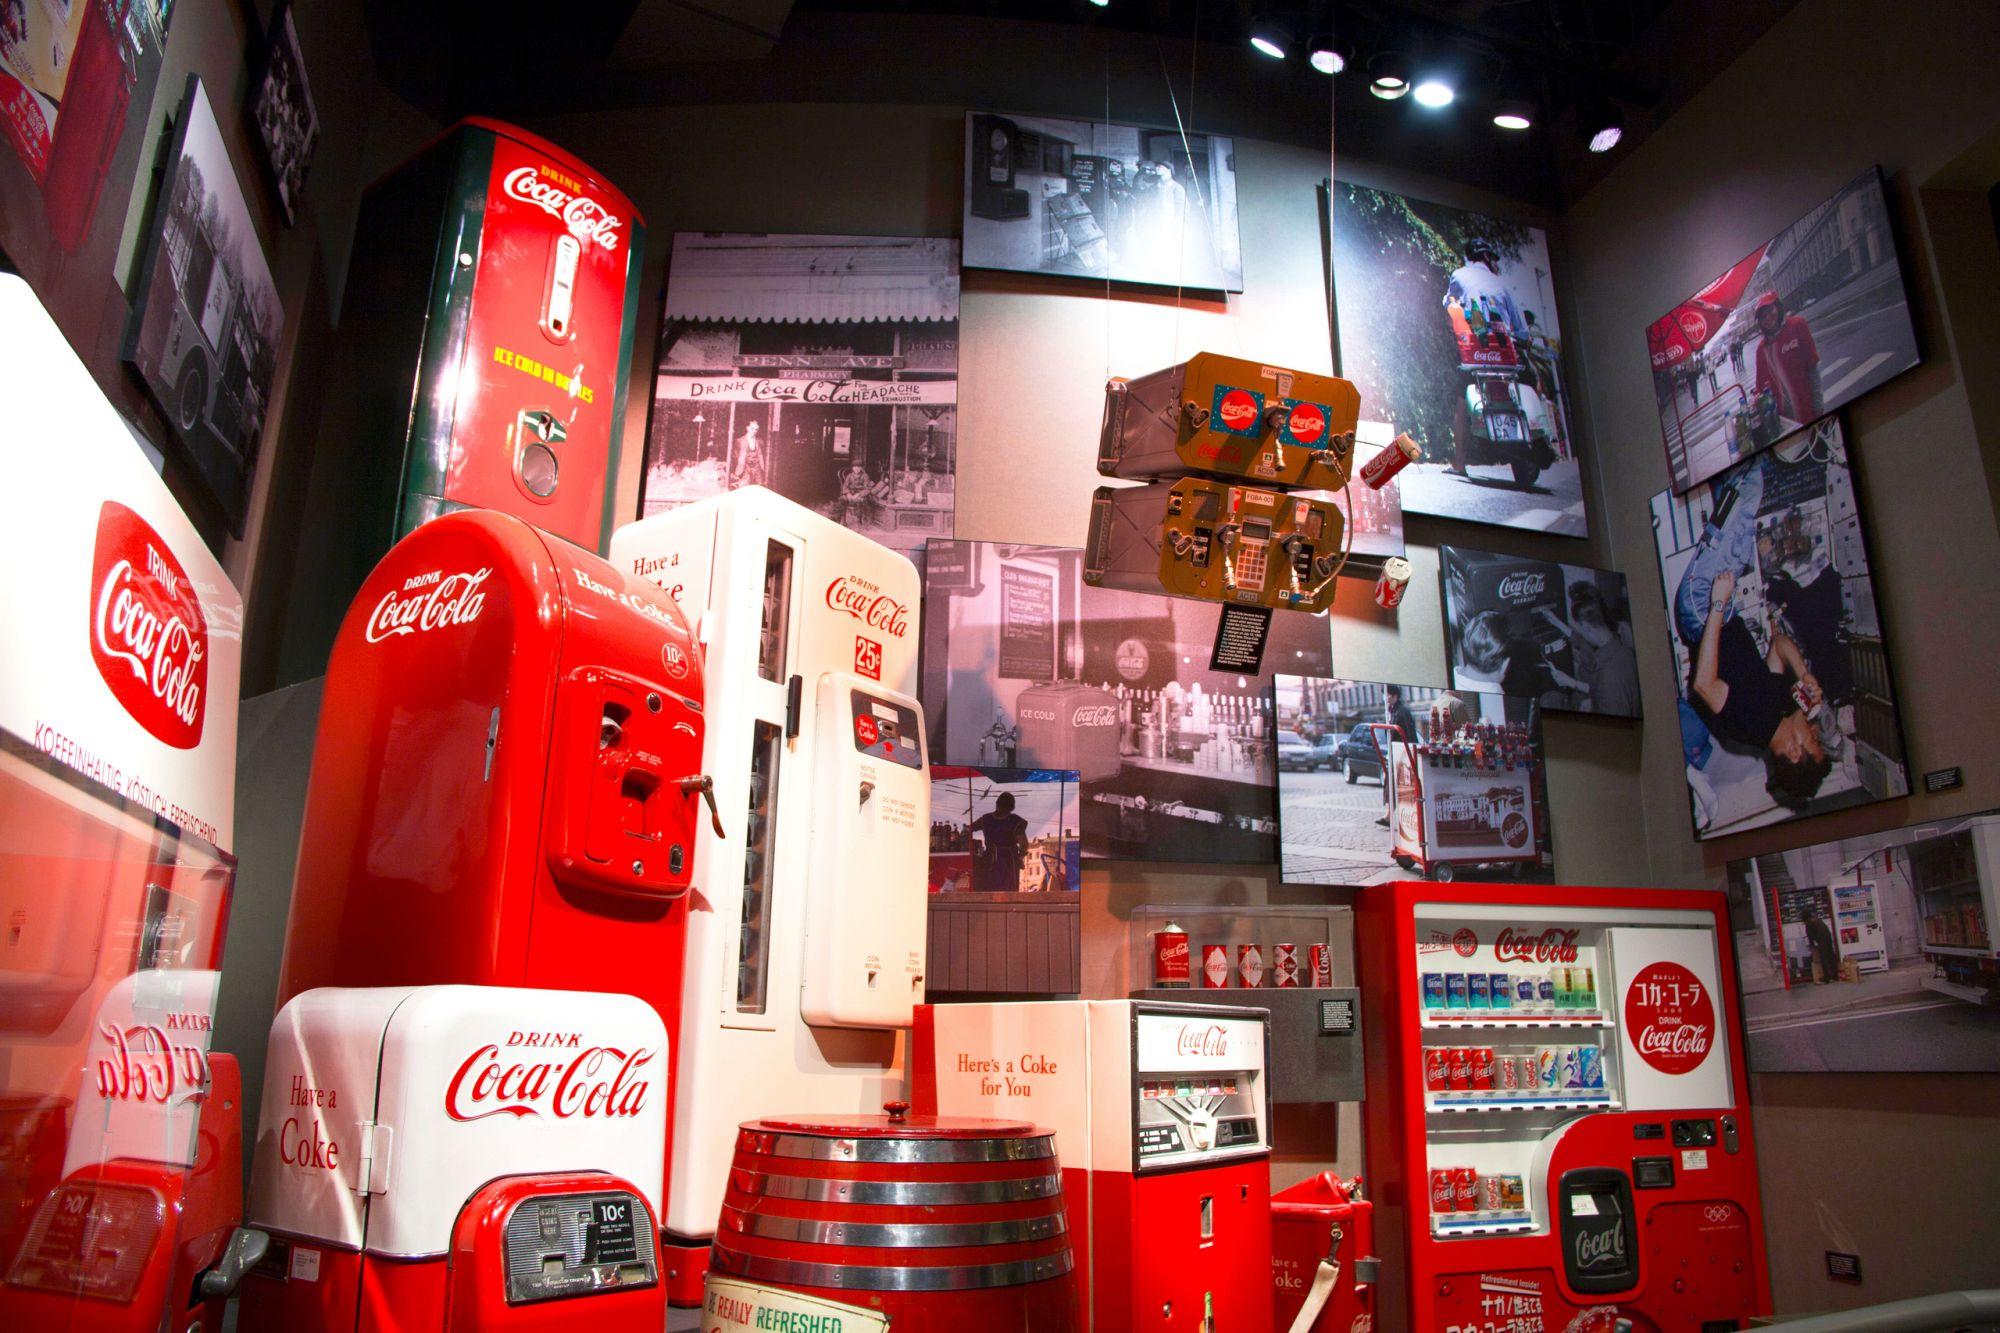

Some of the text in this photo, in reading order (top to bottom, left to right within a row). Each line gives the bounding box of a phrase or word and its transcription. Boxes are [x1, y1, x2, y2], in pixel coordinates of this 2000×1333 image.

[541, 164, 583, 195] DRINK
[503, 166, 623, 251] Coca-Cola
[494, 346, 515, 367] ICE
[514, 353, 542, 378] COLD
[783, 371, 849, 379] PHARMACY
[841, 357, 893, 367] AVE
[690, 381, 746, 397] DRINK
[852, 384, 920, 402] HEADACHE
[145, 543, 179, 600] TRINK
[633, 552, 680, 577] Have a
[403, 569, 442, 591] DRINK
[849, 575, 880, 594] DRINK
[1499, 573, 1545, 599] Coca-Cola
[365, 567, 494, 643] Coca-Cola
[573, 567, 674, 626] Have a Coke
[825, 576, 910, 638] Coca-Cola
[98, 559, 204, 727] Coca-Cola
[857, 638, 881, 671] 25¢
[1020, 708, 1055, 721] ICE COLD
[1072, 706, 1117, 728] Coca-Cola
[1494, 927, 1580, 964] Coca-Cola
[1634, 982, 1701, 1007] コカ・コーラ
[1658, 1016, 1682, 1025] DRINK
[505, 1031, 584, 1048] DRINK
[1639, 1024, 1707, 1054] Coca-Cola
[957, 1053, 1058, 1075] Here's a Coke
[289, 1074, 338, 1110] Have a
[443, 1043, 658, 1123] Coca-Cola
[980, 1076, 1032, 1098] for You
[279, 1116, 340, 1171] Coke
[600, 1204, 625, 1222] 10¢
[717, 1295, 753, 1326] REALLY
